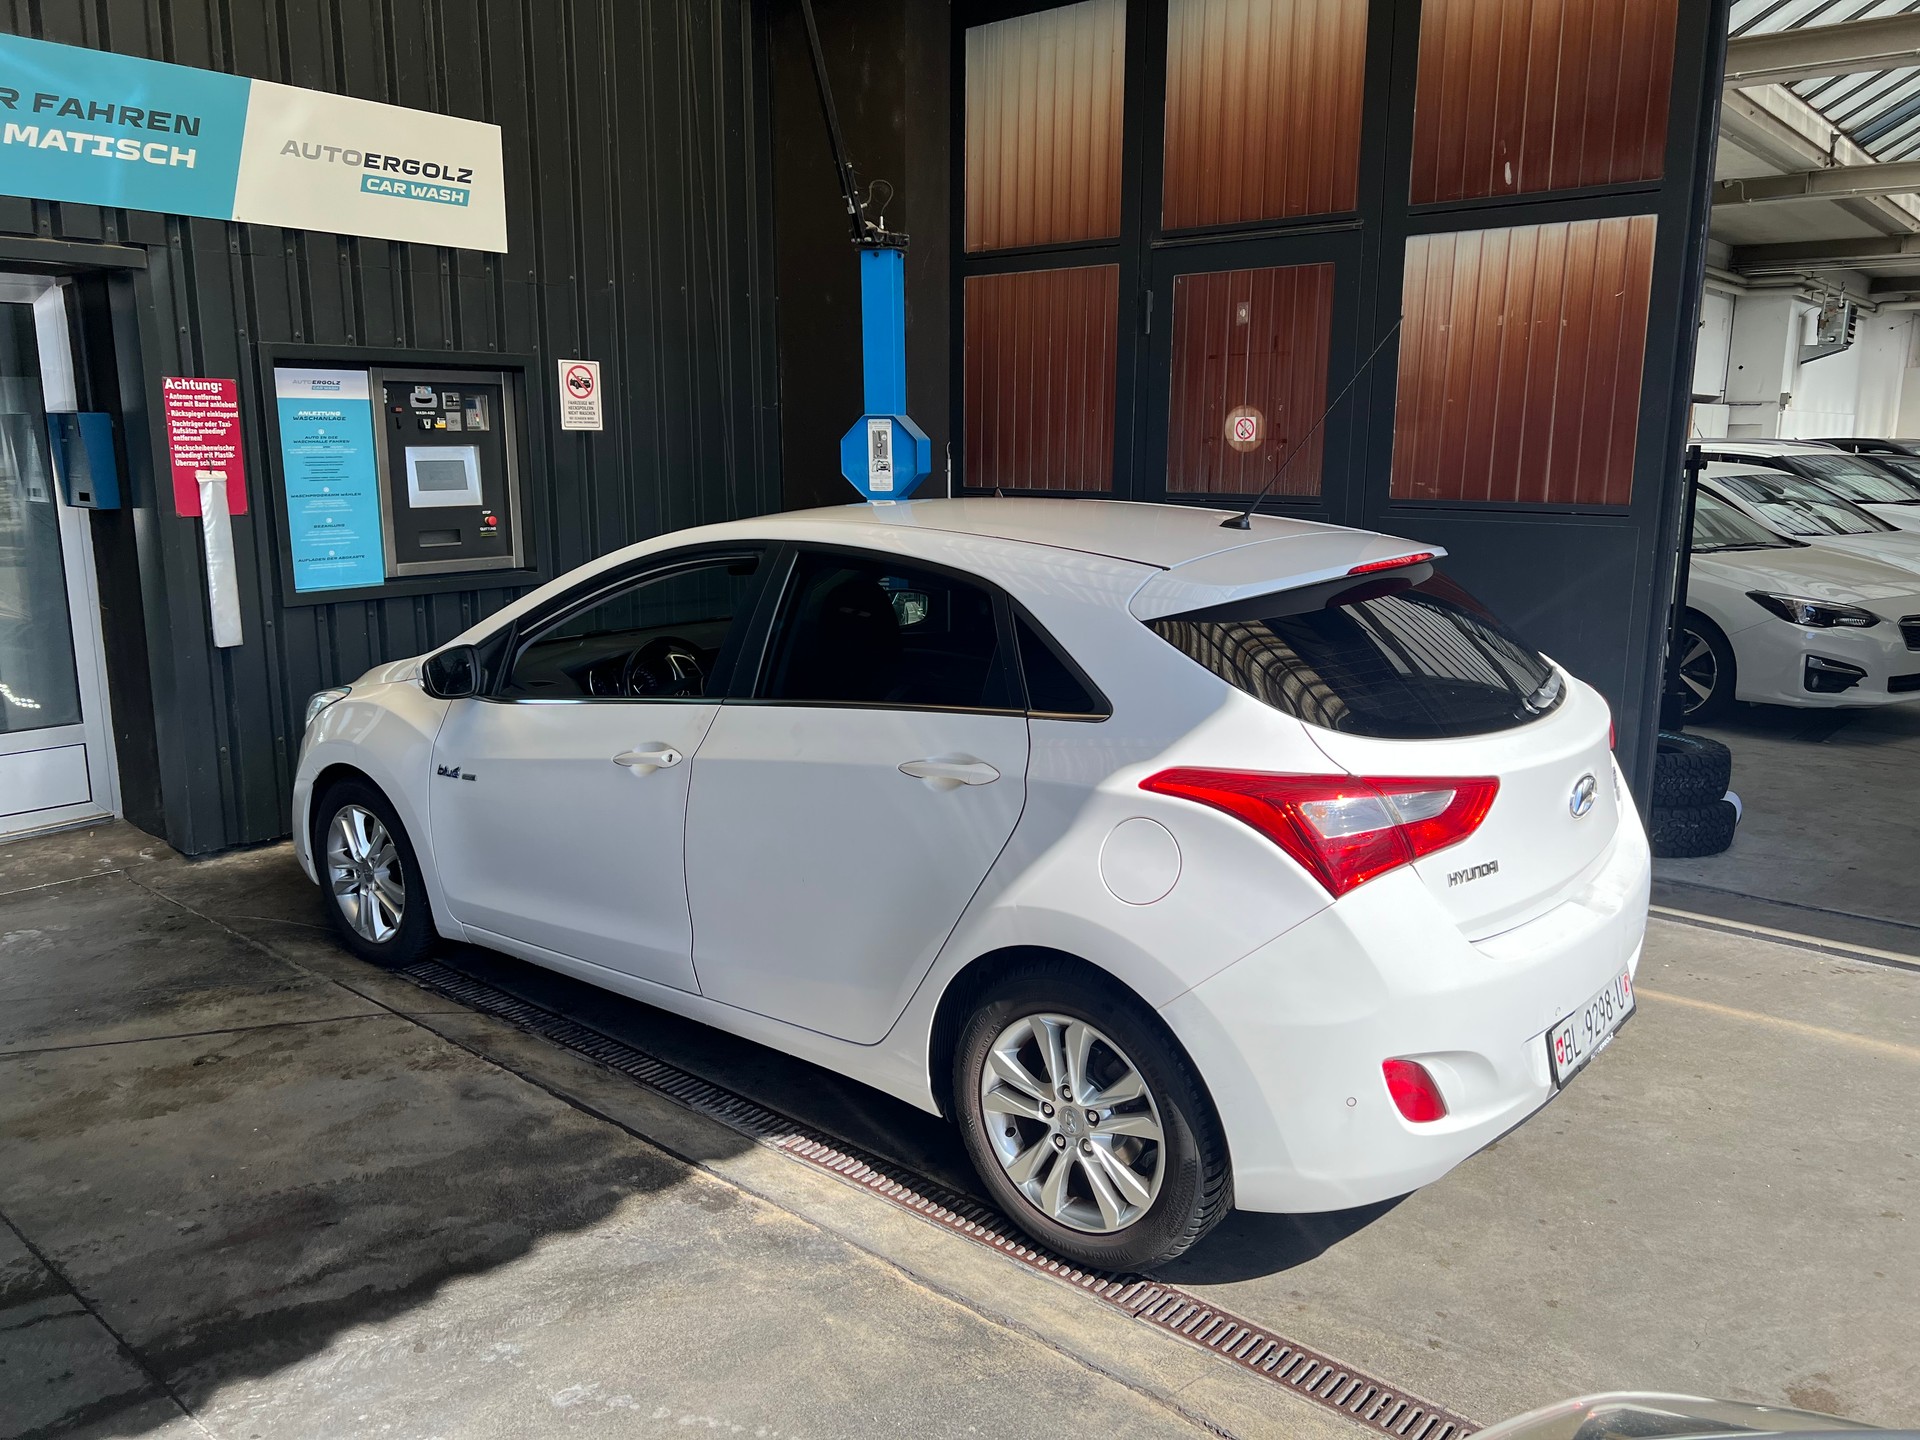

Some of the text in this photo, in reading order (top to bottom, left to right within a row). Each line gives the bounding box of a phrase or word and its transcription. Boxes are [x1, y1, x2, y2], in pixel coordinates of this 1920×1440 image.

[33, 92, 200, 137] FAHREN
[3, 122, 197, 169] MATISCH
[280, 140, 473, 184] AUTOERGOLZ
[366, 178, 464, 203] CAR WASH
[165, 379, 223, 393] Achtung:
[171, 410, 239, 419] Rückspiegel einklappen!
[199, 428, 226, 436] unbedingt
[175, 452, 203, 460] unbedingt
[1447, 860, 1499, 888] HYUNDAI
